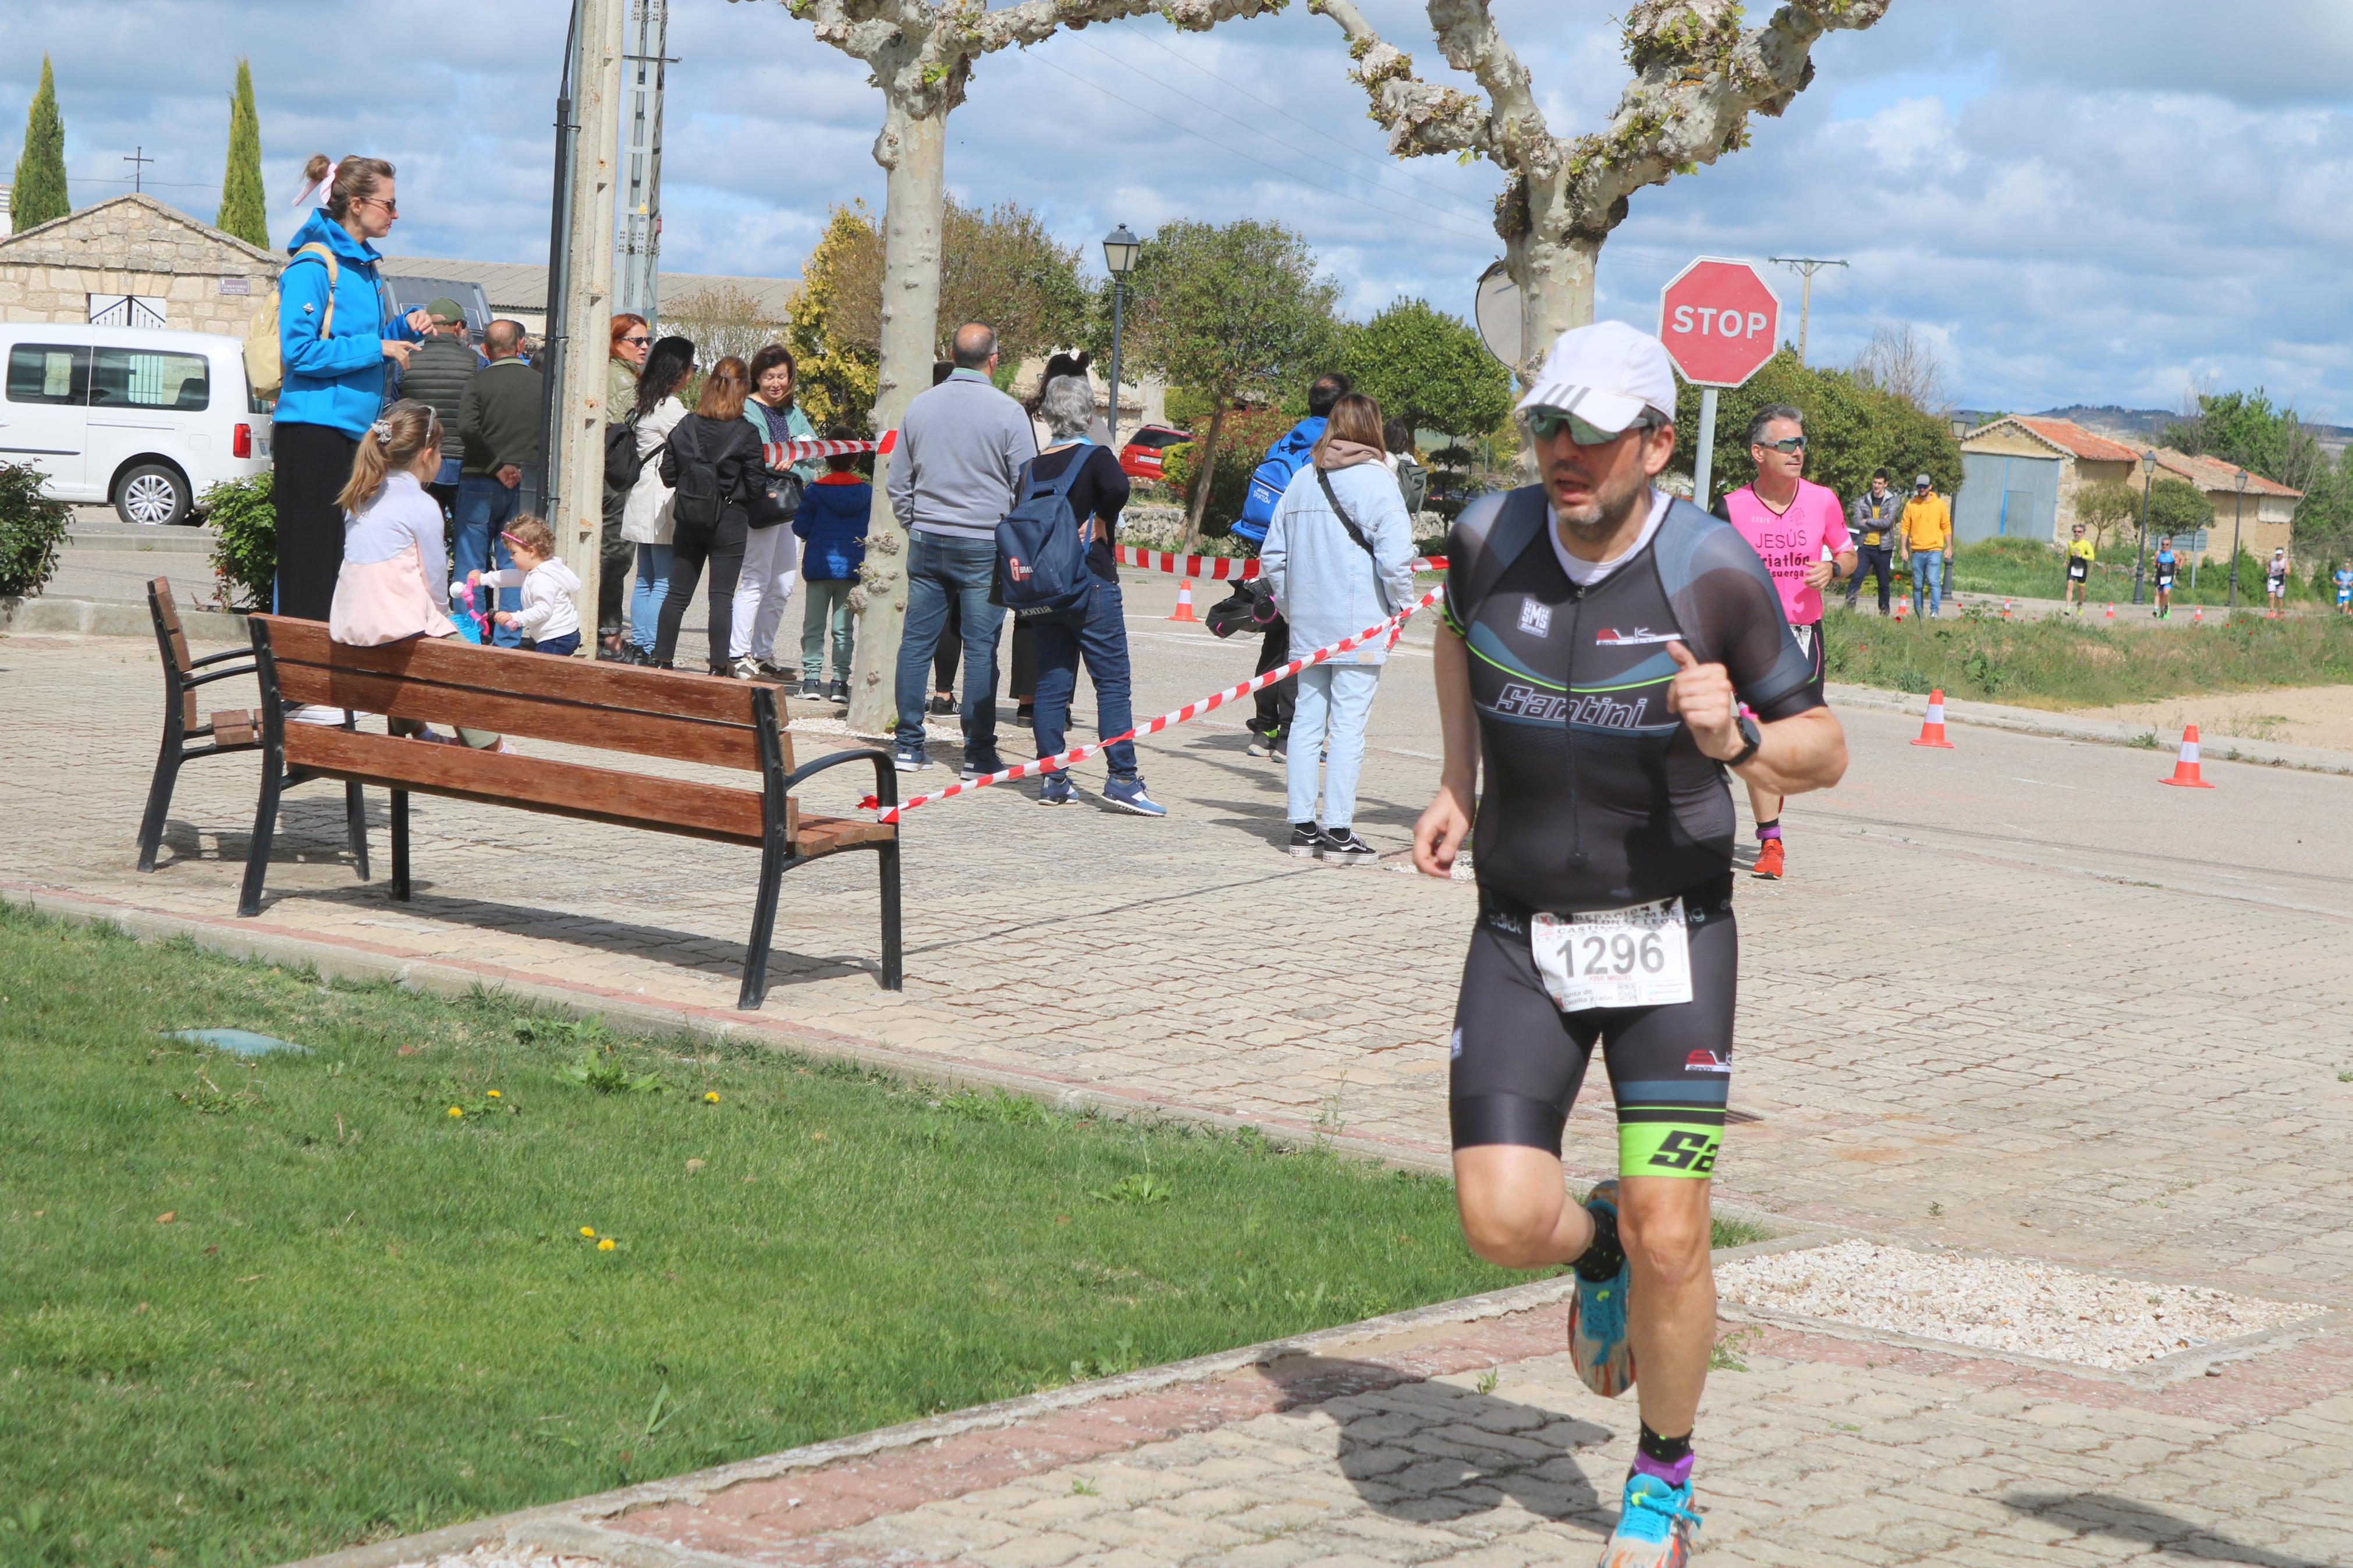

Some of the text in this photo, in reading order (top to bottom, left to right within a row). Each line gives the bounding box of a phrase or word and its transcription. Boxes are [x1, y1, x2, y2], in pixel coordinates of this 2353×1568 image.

[1672, 305, 1767, 339] STOP
[1756, 529, 1807, 549] JESÚS
[1496, 683, 1648, 729] Santini
[1556, 933, 1665, 979] 1296
[1563, 990, 1581, 998] Junta
[1564, 998, 1588, 1006] Castilla
